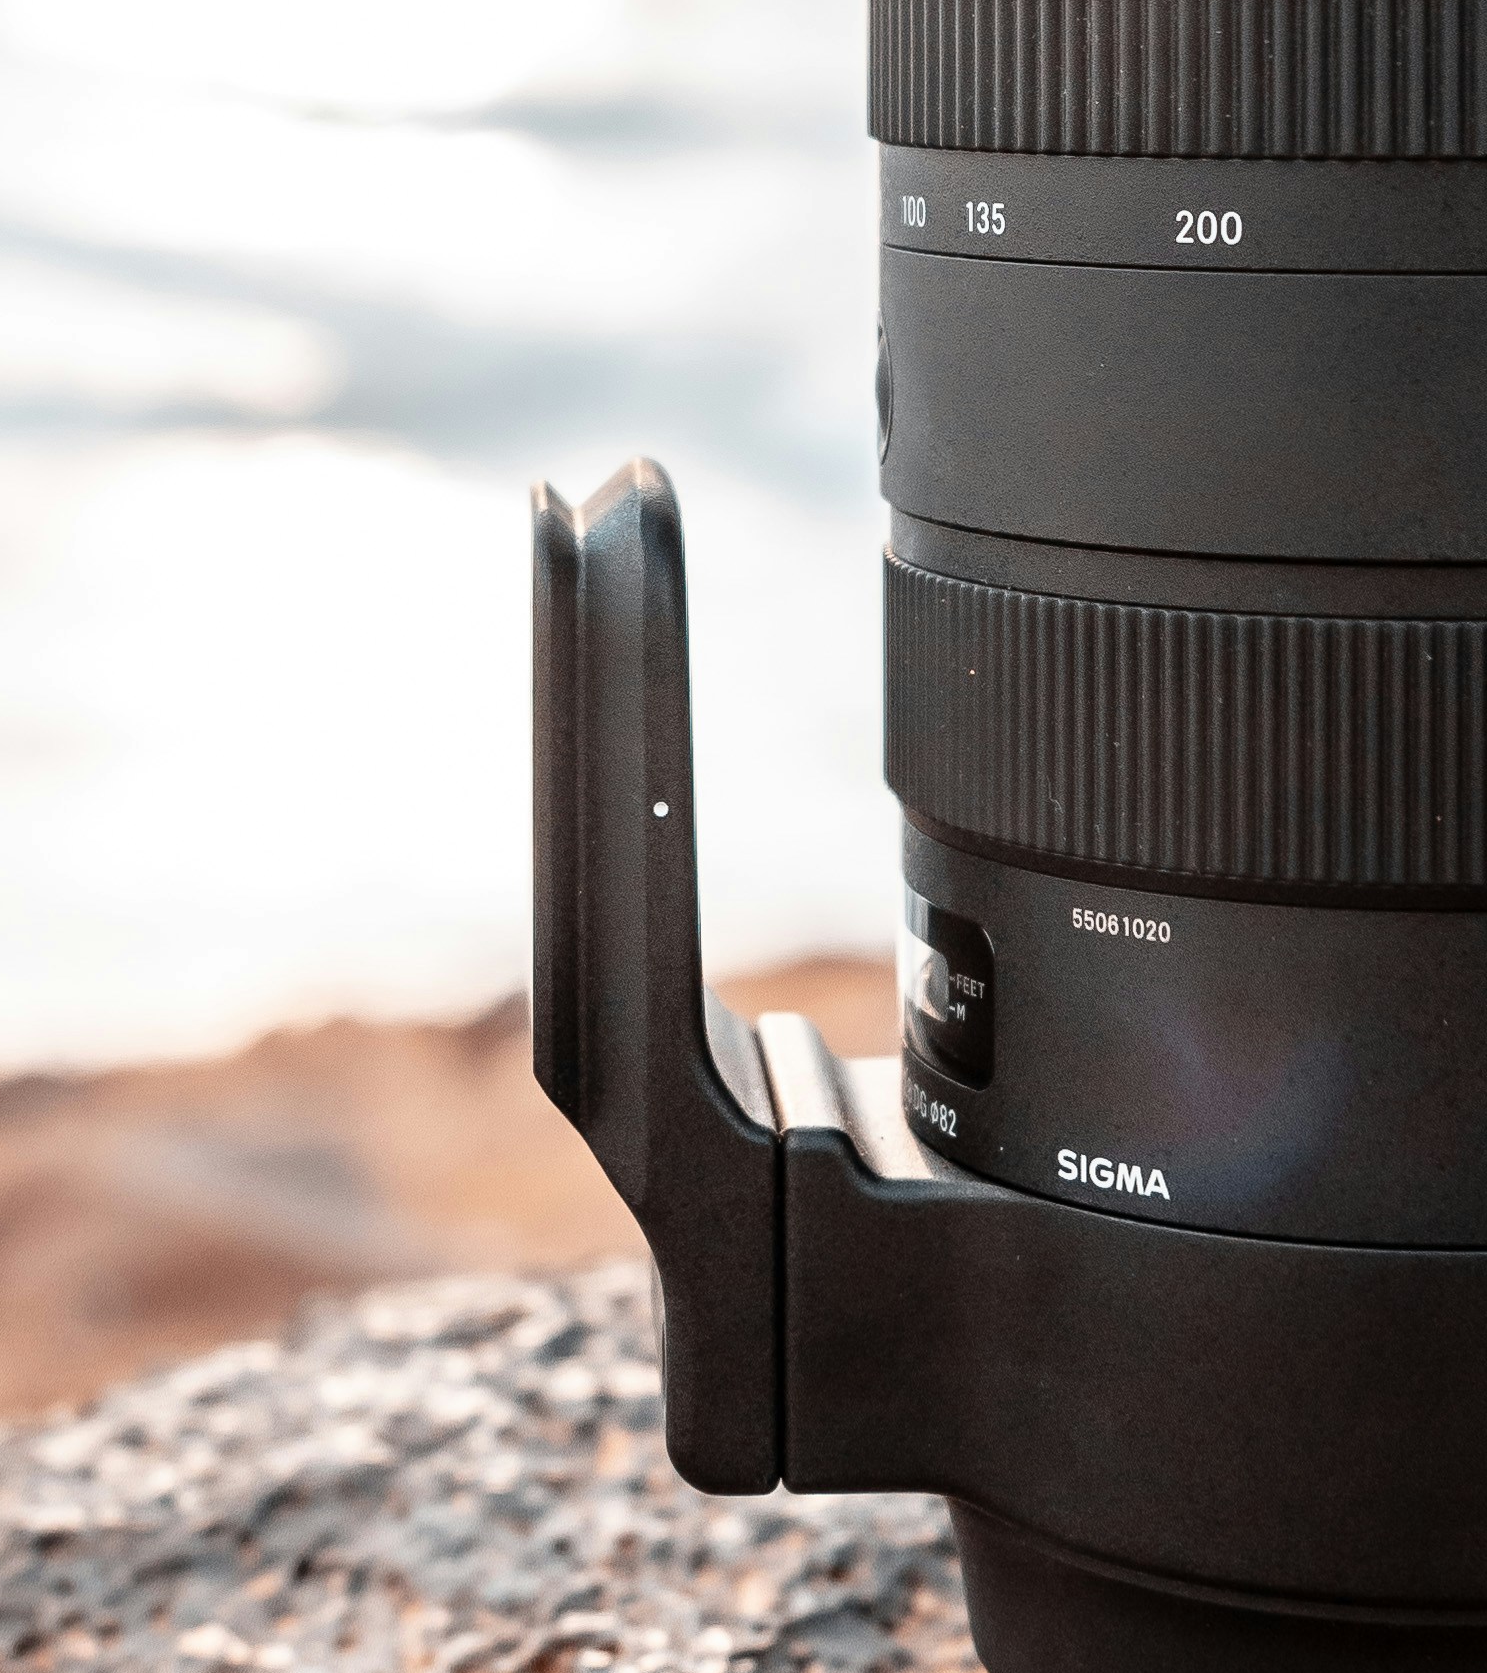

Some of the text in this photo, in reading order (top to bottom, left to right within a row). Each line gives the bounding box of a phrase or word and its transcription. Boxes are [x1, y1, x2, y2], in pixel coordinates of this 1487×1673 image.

[902, 195, 1243, 245] 100 135 200
[1072, 907, 1171, 943] 55061020
[956, 973, 985, 999] FEET
[1057, 1149, 1171, 1201] SIGMA
